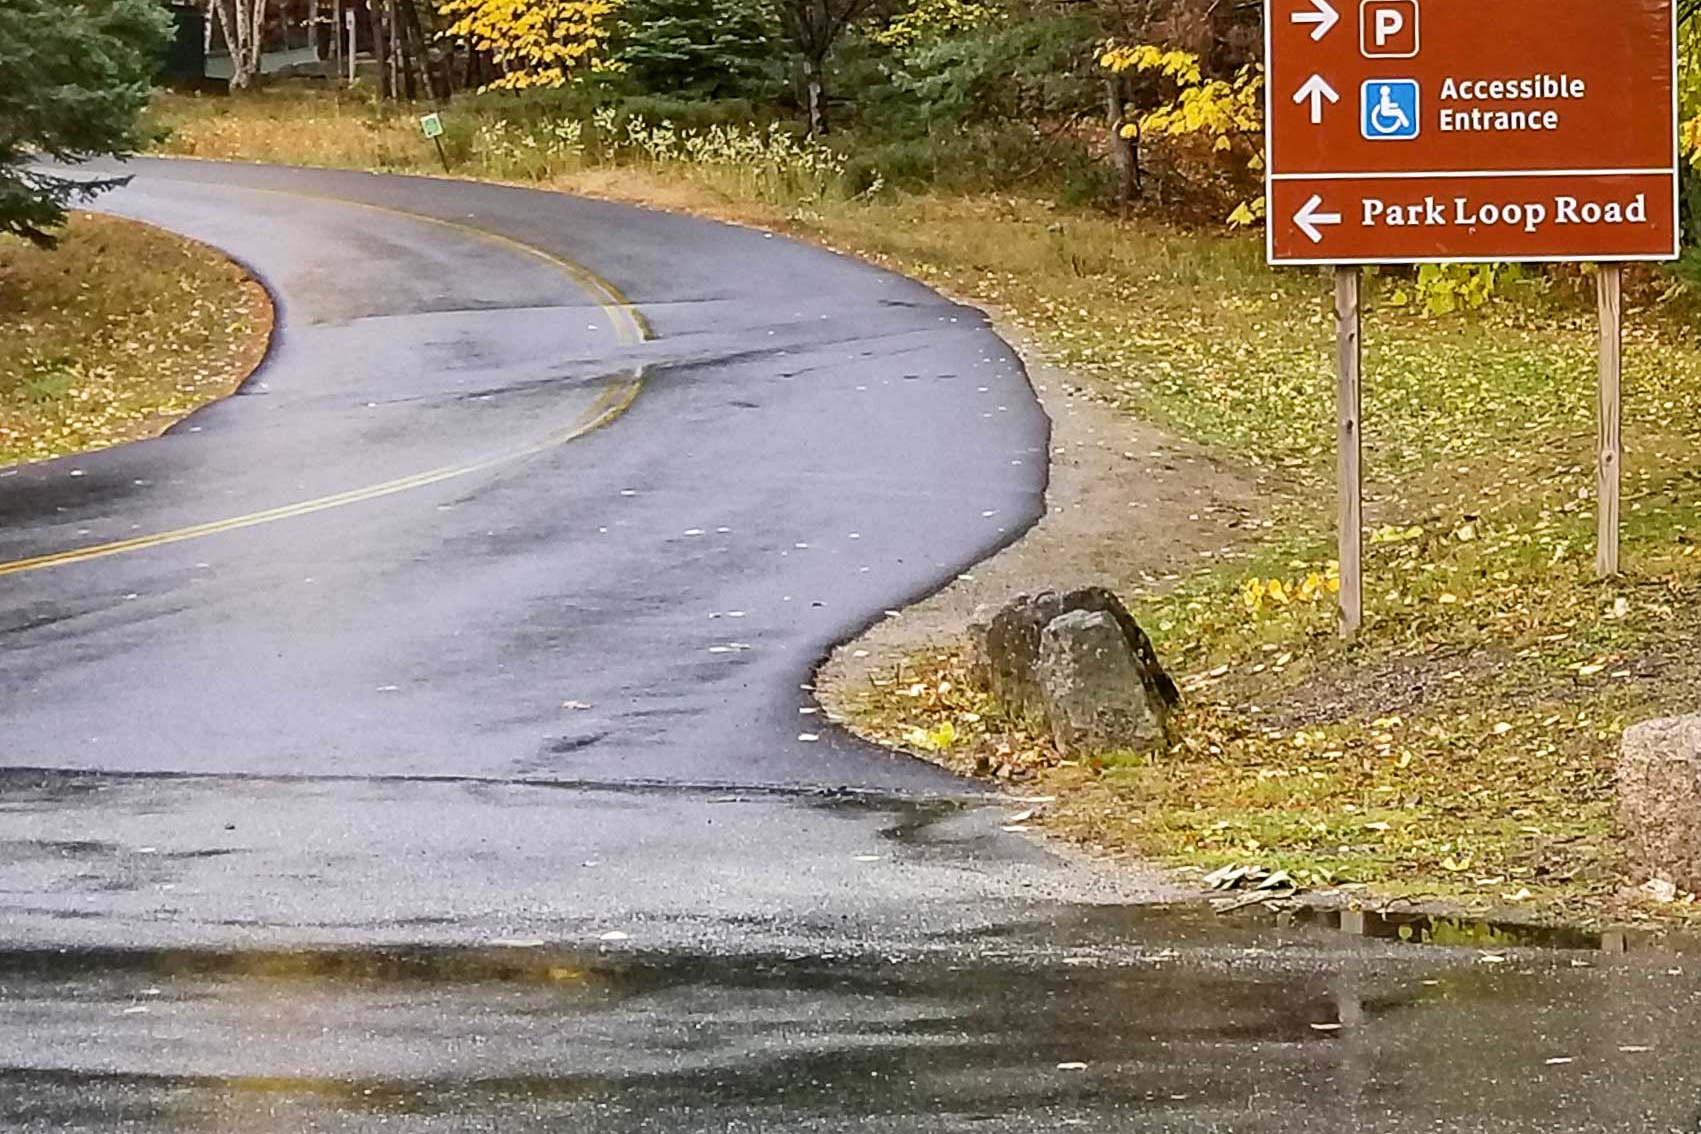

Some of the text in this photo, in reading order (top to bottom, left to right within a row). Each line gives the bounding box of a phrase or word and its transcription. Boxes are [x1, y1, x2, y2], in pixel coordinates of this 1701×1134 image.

[1375, 9, 1403, 46] P
[1440, 74, 1585, 100] Accessible
[1440, 108, 1558, 131] Entrance
[1362, 193, 1647, 231] Park Loop Road
